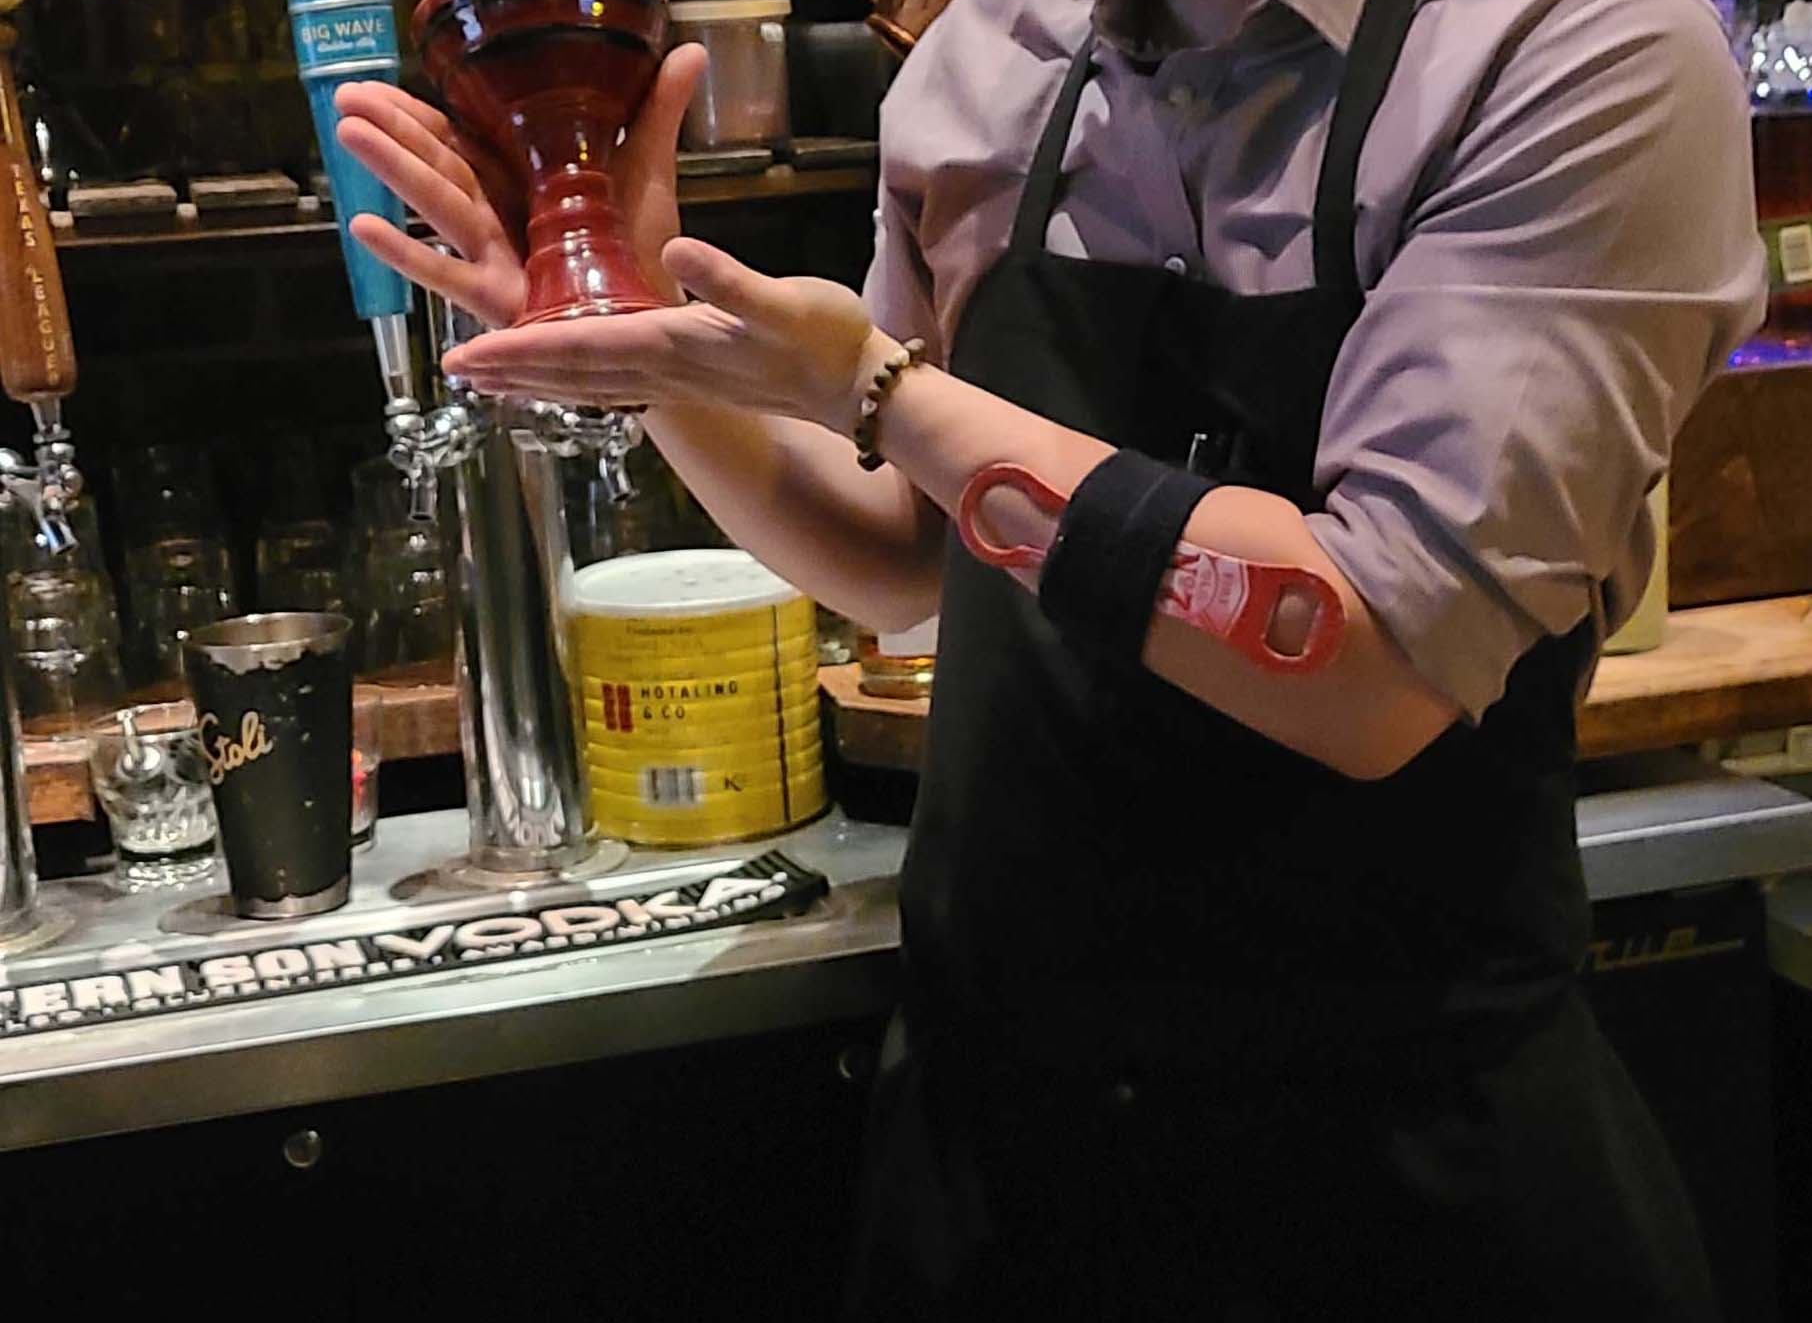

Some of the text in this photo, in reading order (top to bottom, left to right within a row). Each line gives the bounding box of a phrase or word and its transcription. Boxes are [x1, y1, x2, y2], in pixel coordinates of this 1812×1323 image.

[301, 18, 385, 44] BIG WAVE
[11, 163, 36, 247] TEXAS
[641, 680, 738, 699] HOTALING
[198, 710, 273, 786] Stoli
[200, 939, 367, 988] SON
[373, 877, 773, 960] VODKA
